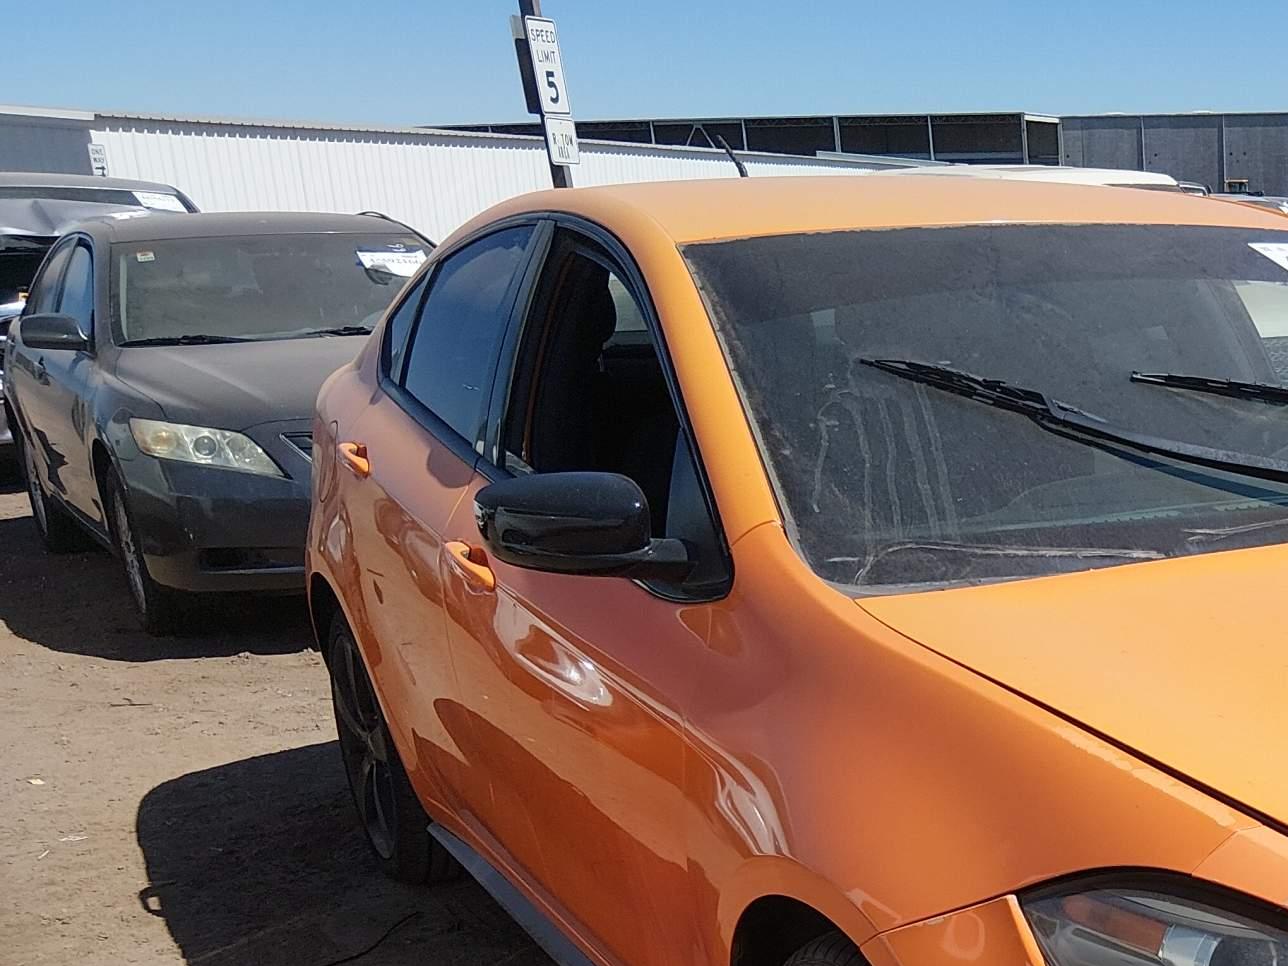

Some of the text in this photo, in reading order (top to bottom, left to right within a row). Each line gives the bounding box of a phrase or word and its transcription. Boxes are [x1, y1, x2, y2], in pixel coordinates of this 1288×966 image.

[530, 28, 556, 44] SPEED
[537, 49, 557, 64] LIMIT
[545, 70, 560, 104] 5
